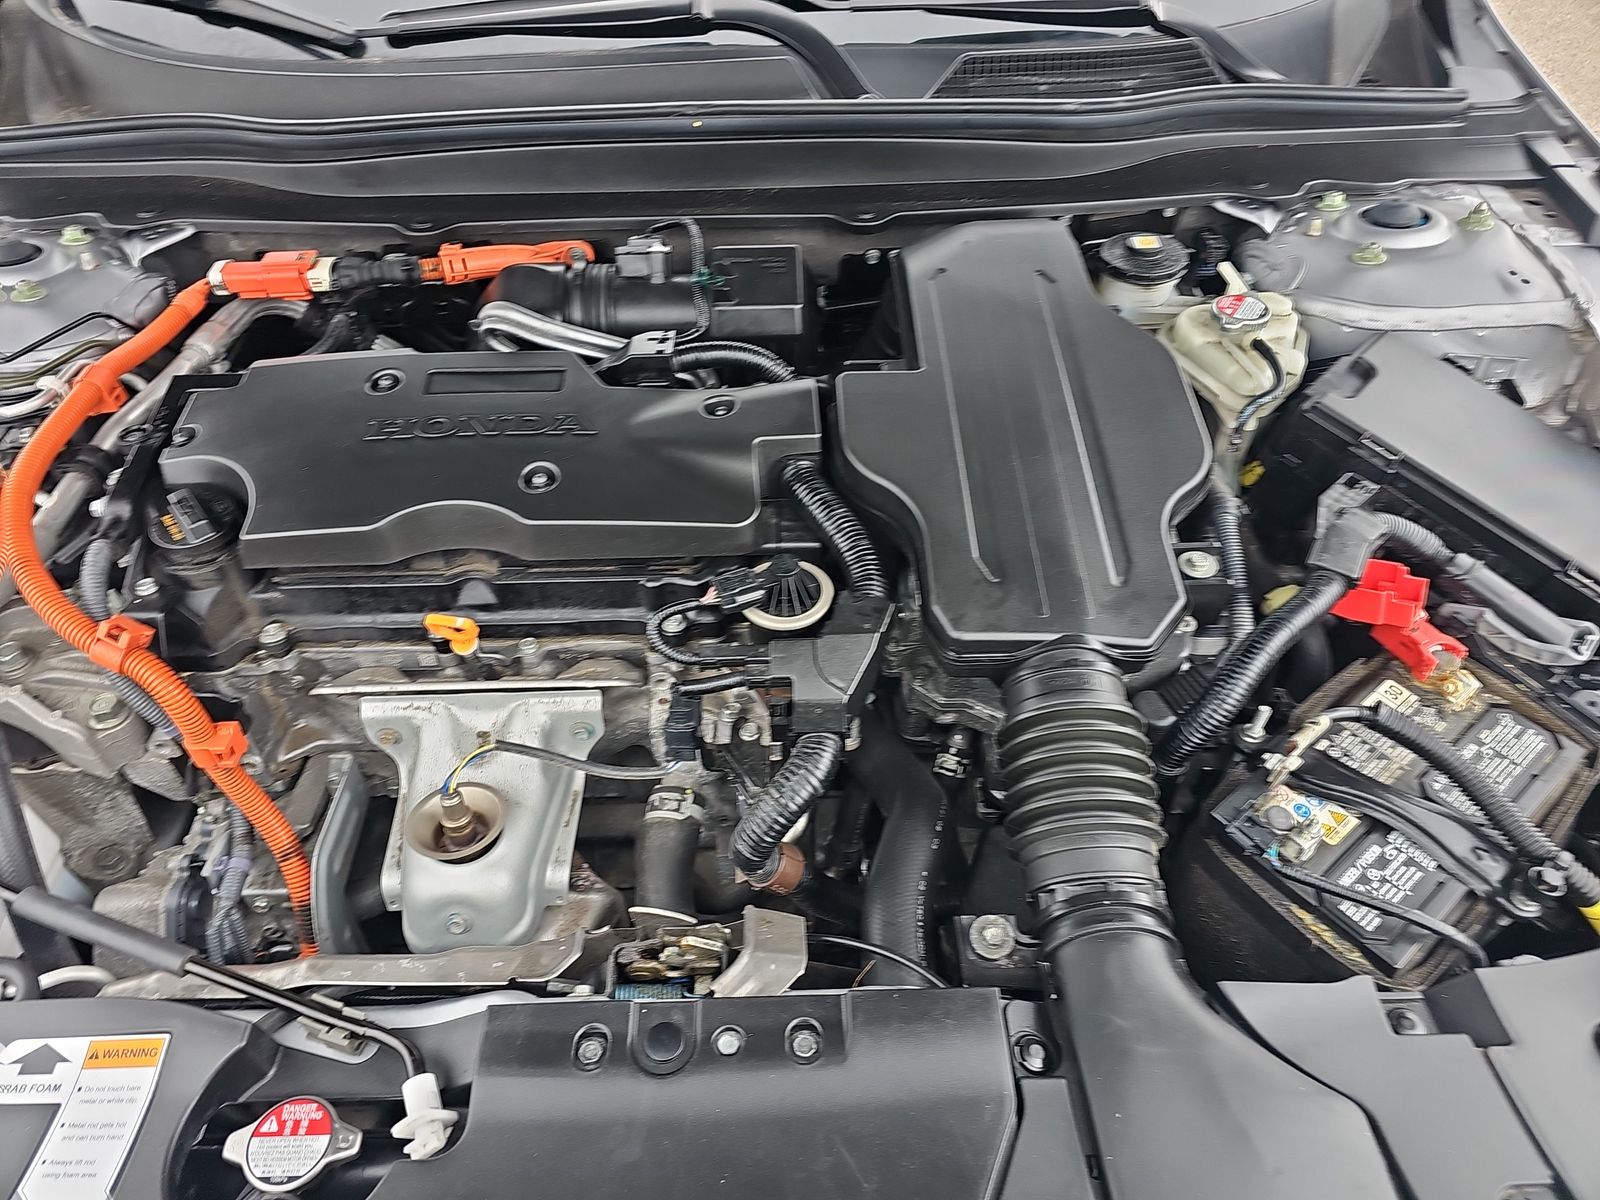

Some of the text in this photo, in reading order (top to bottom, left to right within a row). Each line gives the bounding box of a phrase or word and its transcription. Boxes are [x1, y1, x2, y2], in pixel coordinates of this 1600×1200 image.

[362, 413, 599, 441] HONDA
[102, 1048, 158, 1060] WARNING
[29, 1083, 63, 1094] FOAM
[84, 1085, 94, 1093] Do
[95, 1085, 106, 1093] not
[79, 1097, 97, 1105] metal
[283, 1103, 319, 1112] DANGER
[68, 1121, 86, 1129] Metal
[87, 1121, 98, 1129] rod
[61, 1134, 75, 1142] and
[48, 1159, 74, 1167] Always
[42, 1172, 61, 1180] using
